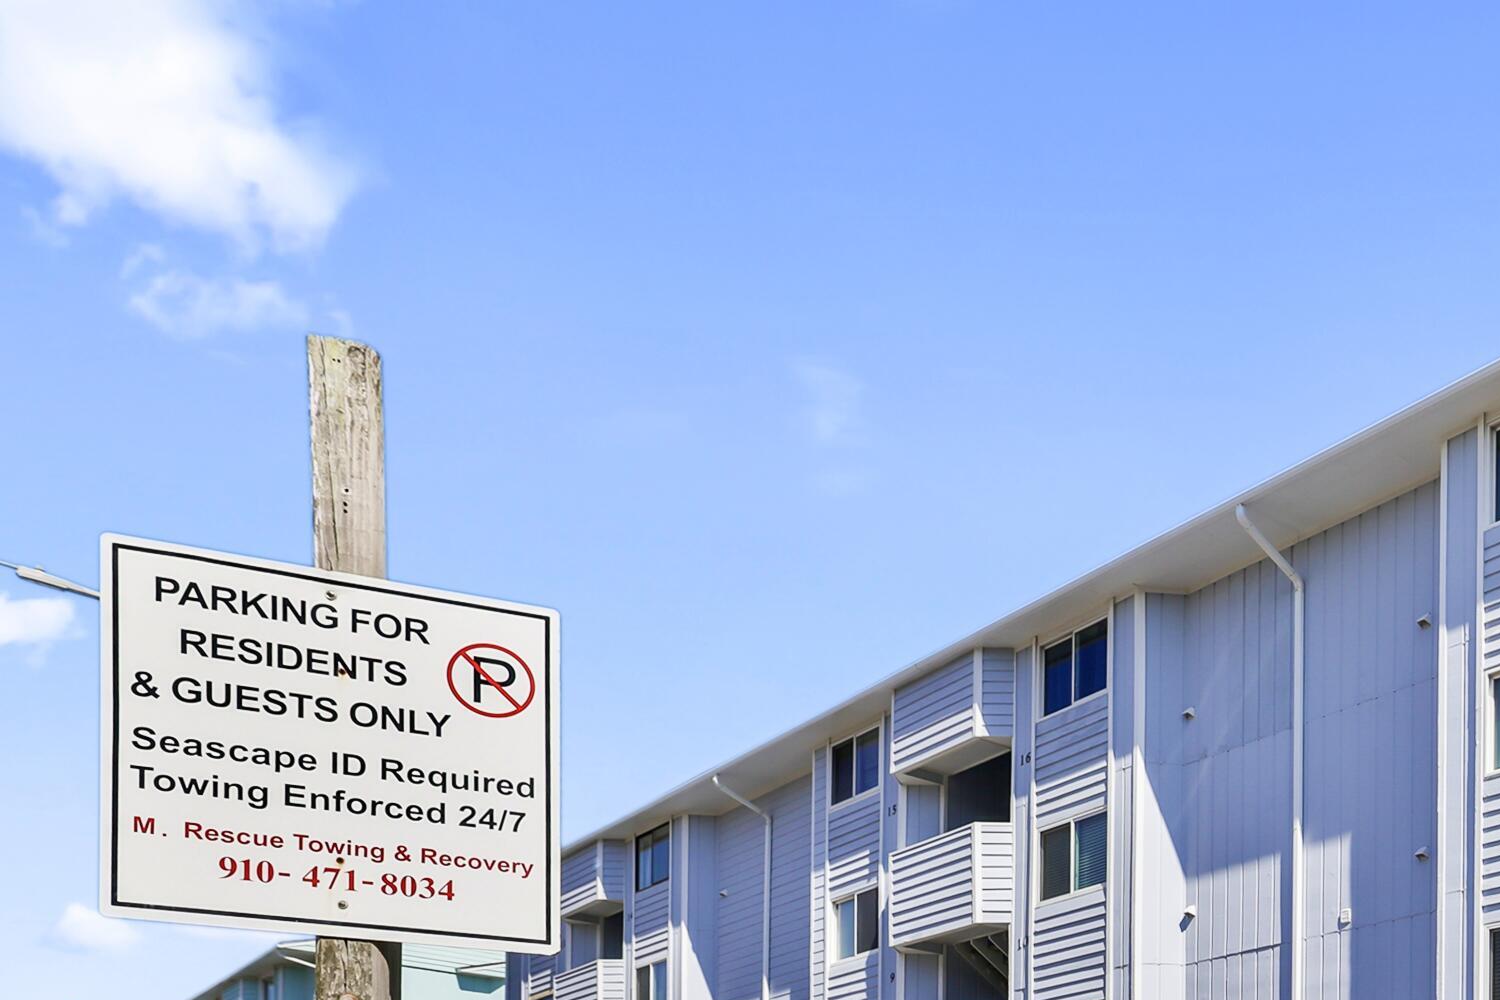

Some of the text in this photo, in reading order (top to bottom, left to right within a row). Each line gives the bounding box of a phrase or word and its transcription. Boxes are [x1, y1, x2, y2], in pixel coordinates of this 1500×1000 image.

[155, 575, 430, 645] PARKING FOR
[180, 628, 408, 687] RESIDENTS
[130, 670, 452, 738] & GUESTS ONLY
[131, 726, 535, 799] Seascape ID Required
[1020, 751, 1031, 766] 16
[129, 764, 526, 833] Towing Enforced 24/7
[184, 821, 284, 849] Rescue
[293, 833, 385, 864] Towing
[394, 846, 411, 862] &
[420, 847, 534, 879] Recovery
